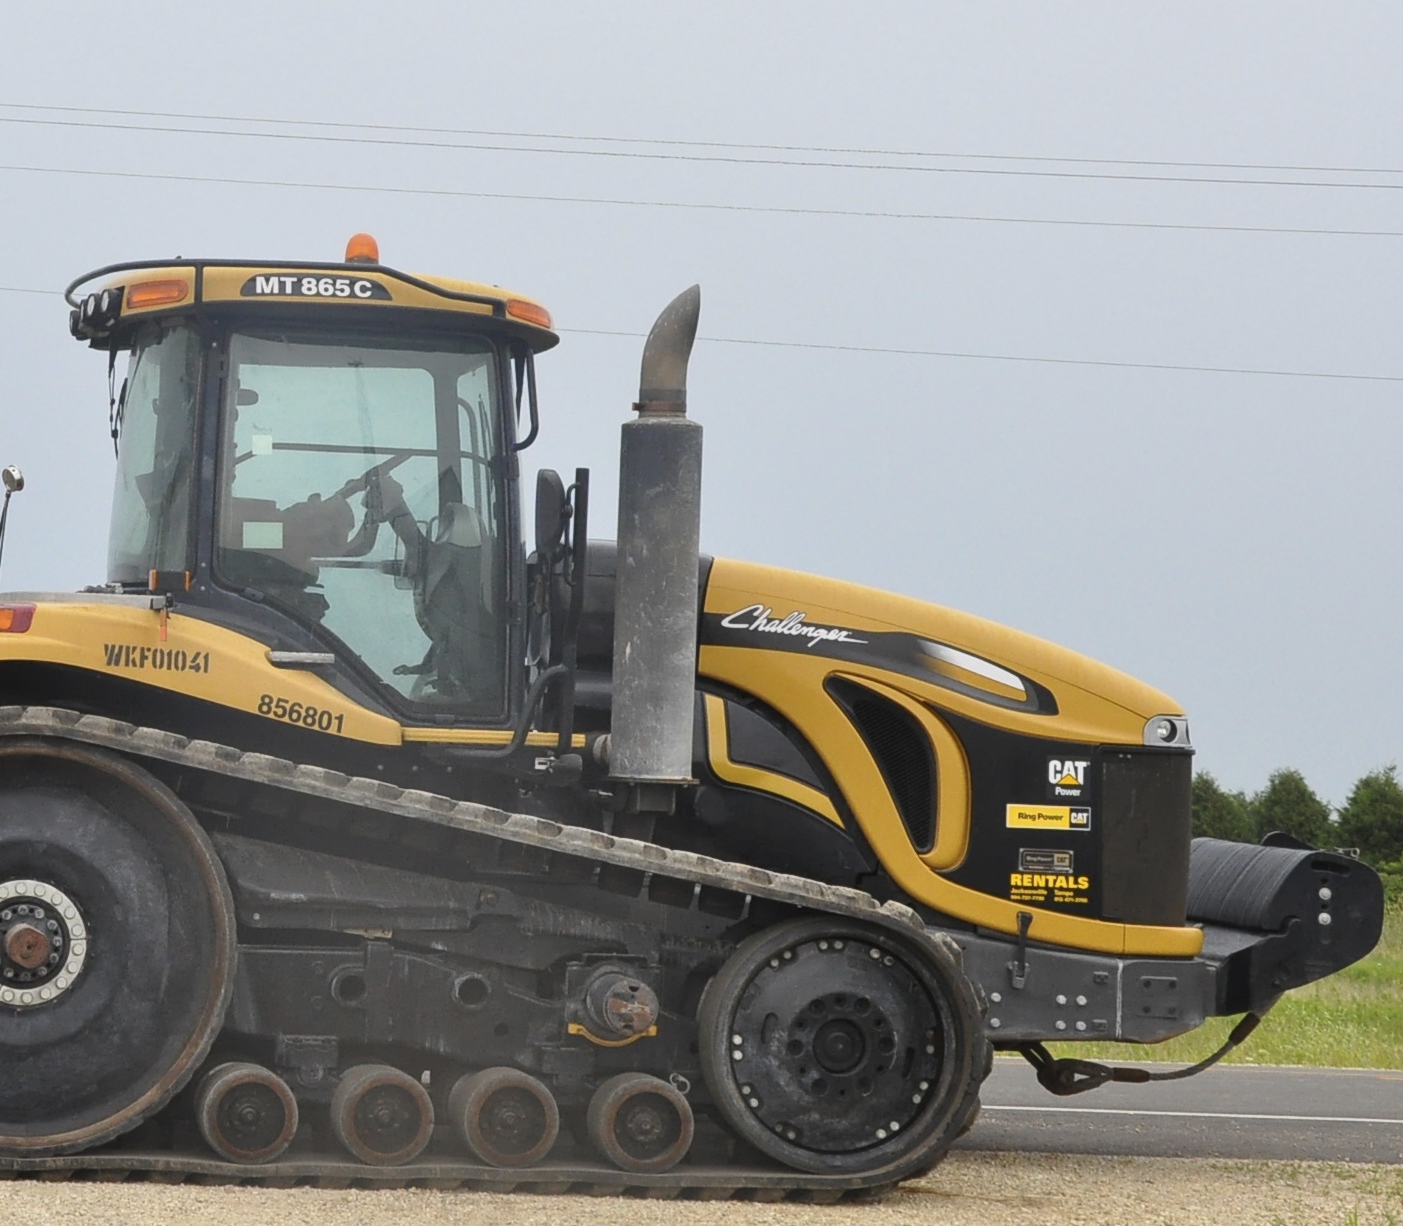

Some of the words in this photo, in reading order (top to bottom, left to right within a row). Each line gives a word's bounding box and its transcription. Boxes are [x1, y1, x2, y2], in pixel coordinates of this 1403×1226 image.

[255, 276, 298, 294] MT
[301, 277, 351, 297] 865
[353, 280, 373, 298] C
[721, 604, 869, 647] Challenger
[103, 643, 210, 674] WKF01041
[257, 693, 345, 734] 856801
[1048, 759, 1088, 785] CAT
[1055, 786, 1082, 796] Power
[1018, 812, 1037, 822] Ring
[1038, 813, 1064, 821] Power
[1070, 812, 1088, 824] CAT
[1010, 873, 1089, 889] RENTALS
